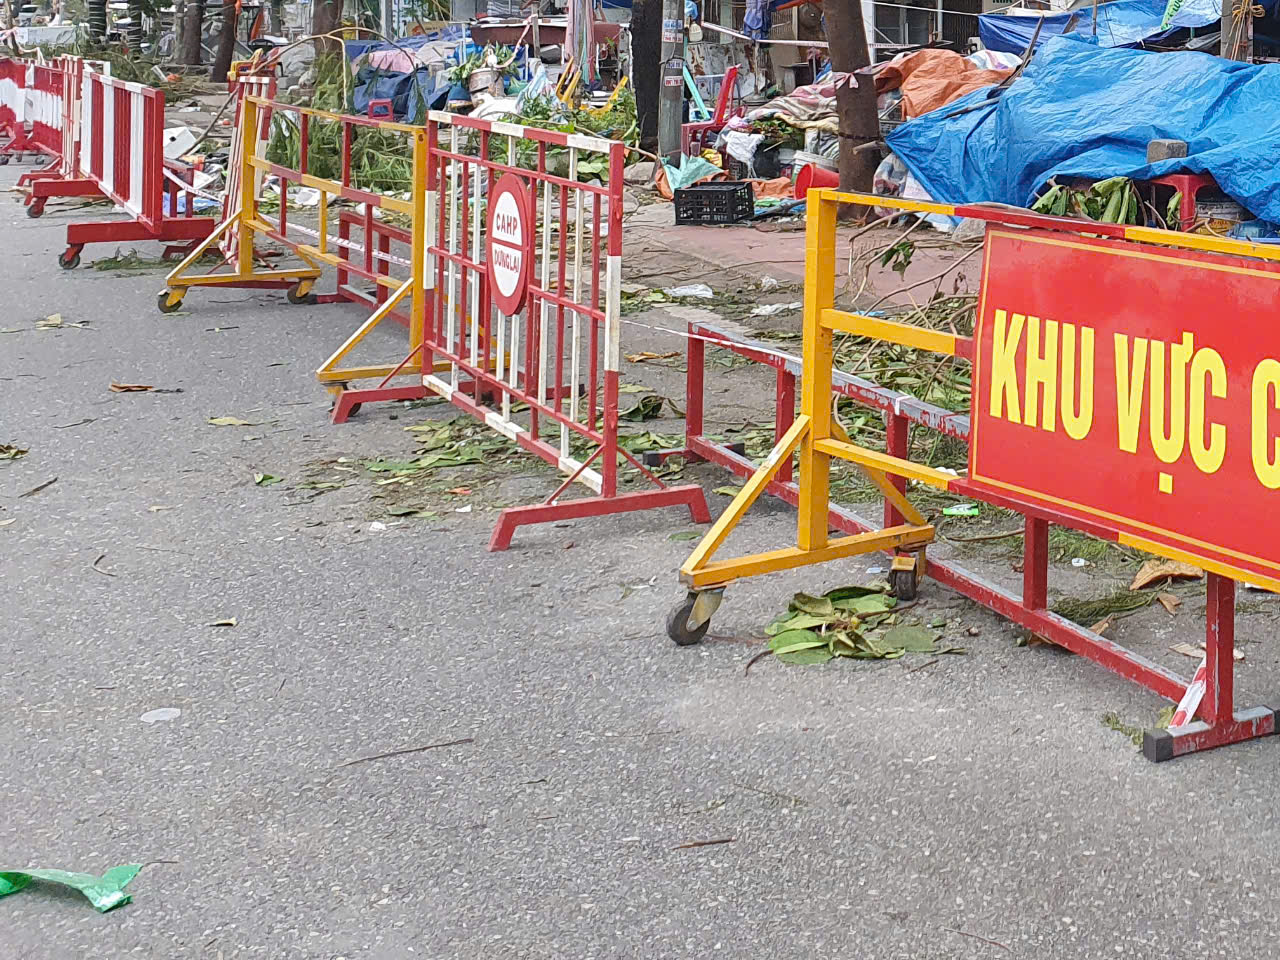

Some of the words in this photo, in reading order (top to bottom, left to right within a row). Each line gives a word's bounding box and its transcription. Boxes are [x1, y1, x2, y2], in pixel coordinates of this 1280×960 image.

[496, 213, 517, 235] CAHP
[989, 309, 1095, 441] KHU
[1114, 331, 1228, 495] VỰC
